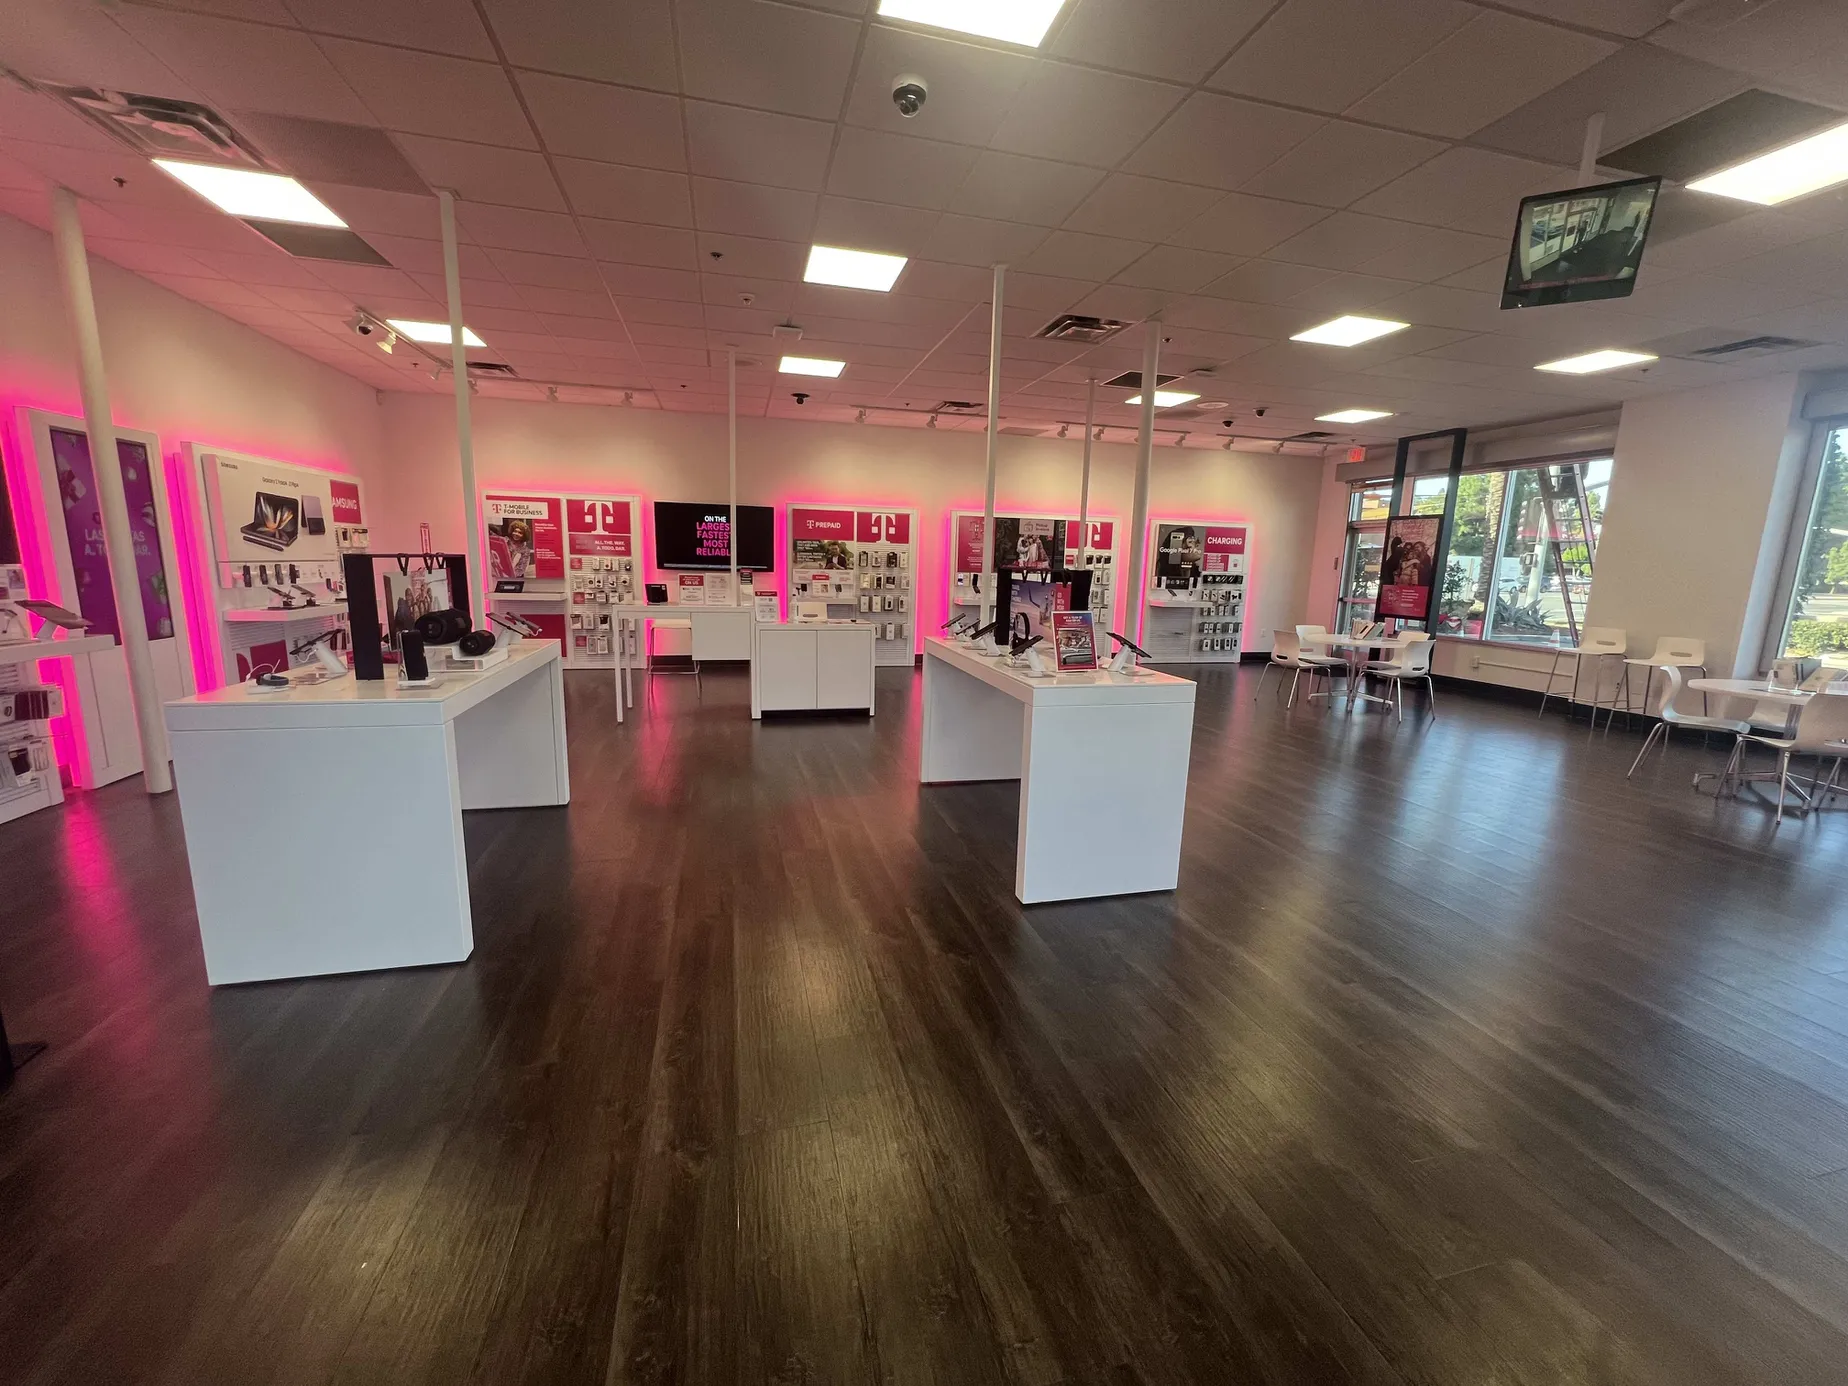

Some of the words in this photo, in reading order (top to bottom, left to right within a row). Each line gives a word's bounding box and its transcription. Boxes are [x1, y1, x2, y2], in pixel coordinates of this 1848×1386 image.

[332, 496, 357, 510] AMSUNG
[704, 515, 714, 523] ON
[696, 522, 731, 532] LARGES
[703, 540, 728, 548] MOST
[1207, 536, 1243, 545] CHARGING
[696, 548, 731, 557] RELIABL
[1159, 546, 1178, 554] Google
